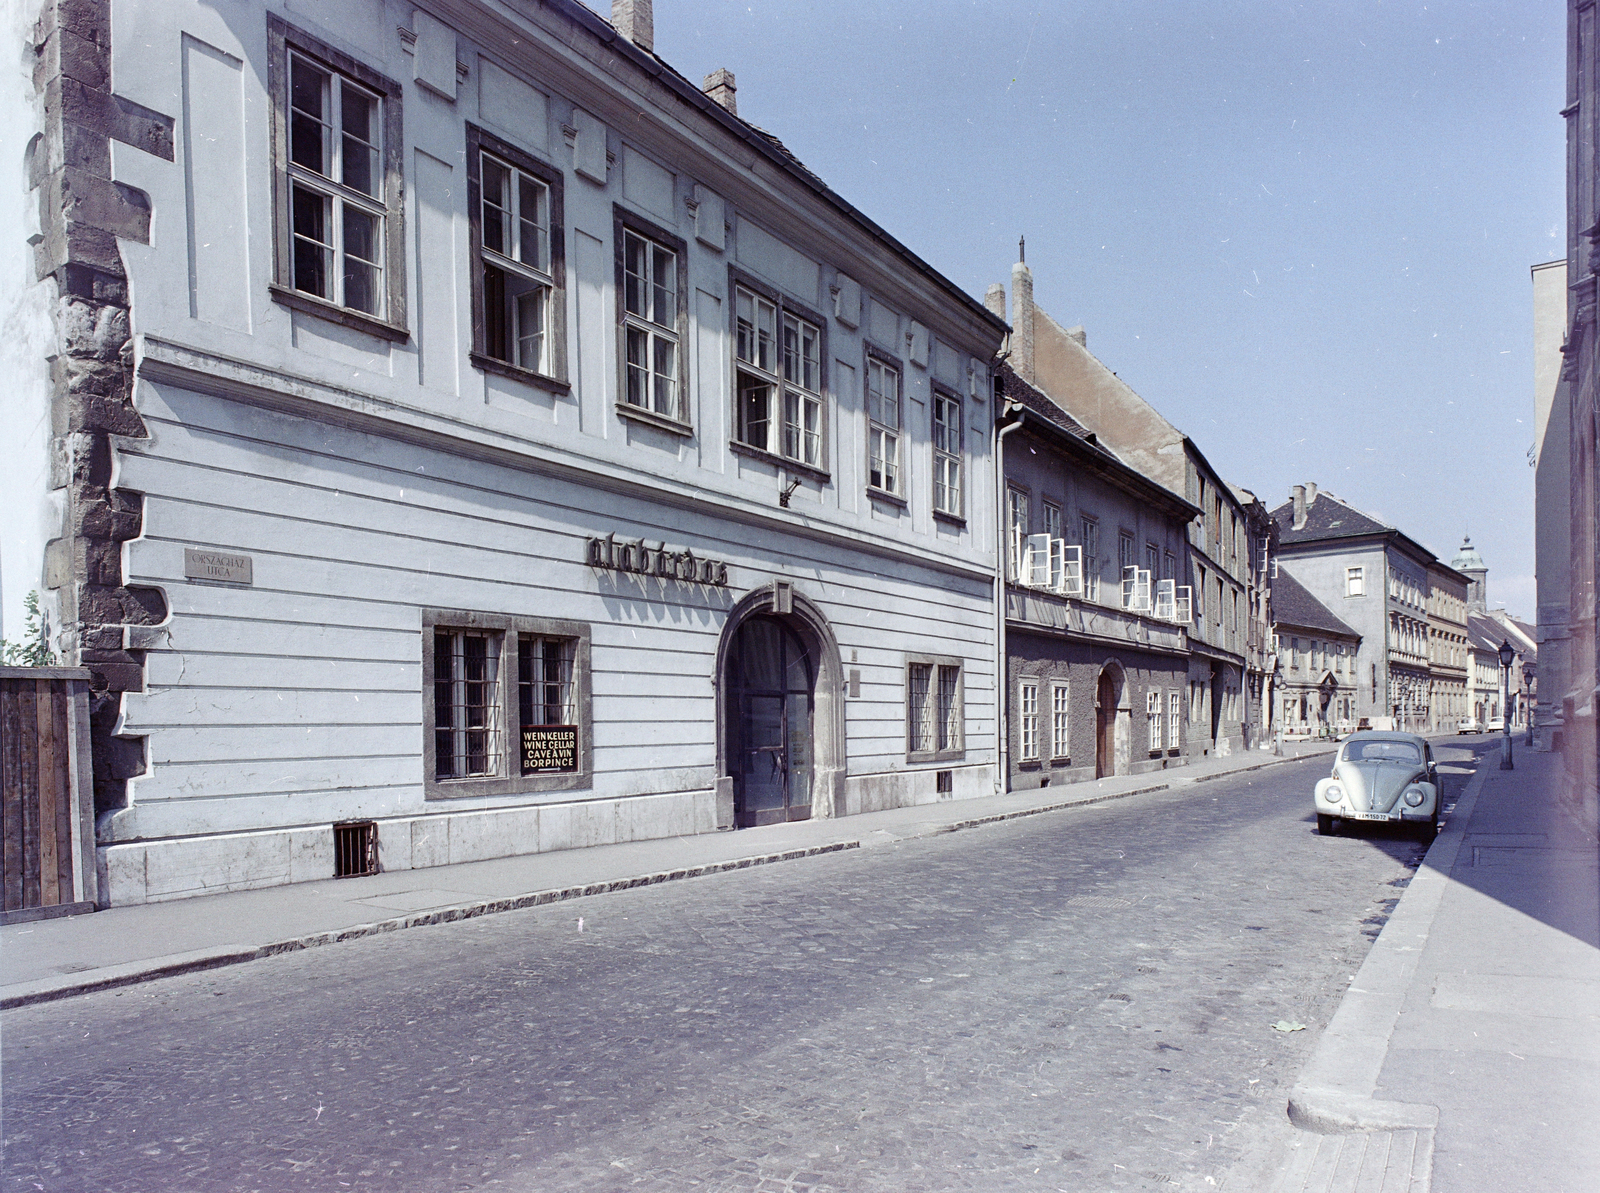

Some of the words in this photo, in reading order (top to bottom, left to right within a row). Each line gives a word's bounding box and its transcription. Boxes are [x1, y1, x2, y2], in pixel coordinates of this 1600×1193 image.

[207, 566, 231, 577] UTCA
[523, 731, 575, 741] WEINKELLER
[523, 741, 547, 750] WINE
[548, 740, 575, 749] CELLAR
[527, 749, 551, 759] CAVE
[558, 749, 572, 758] VIN
[523, 757, 574, 768] BORPINCE
